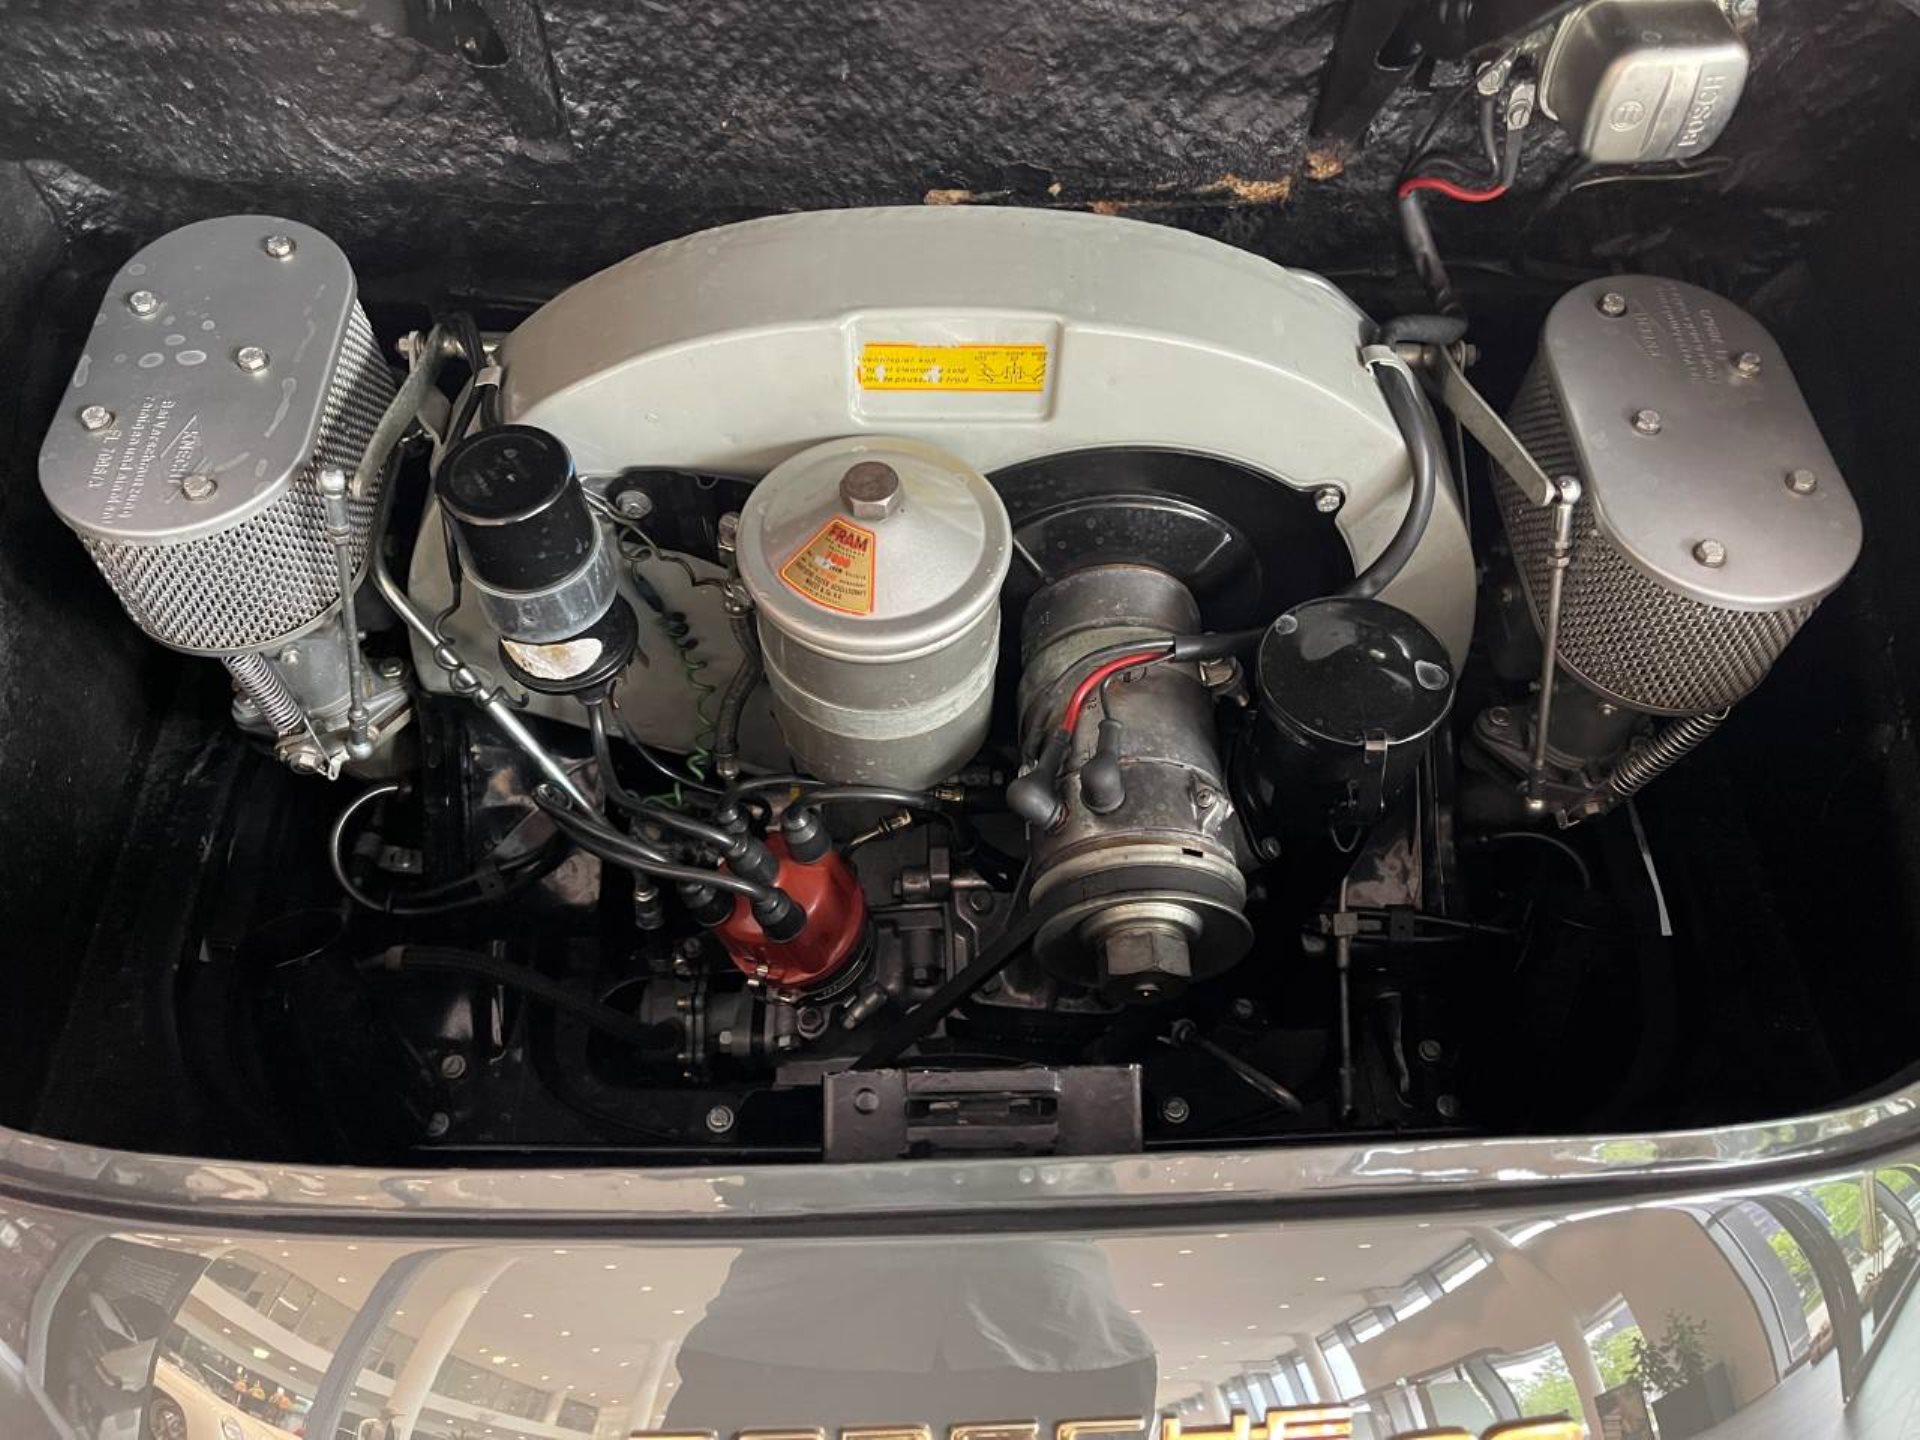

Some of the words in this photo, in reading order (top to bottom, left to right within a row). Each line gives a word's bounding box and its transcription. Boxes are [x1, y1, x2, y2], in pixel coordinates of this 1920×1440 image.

[1677, 75, 1726, 147] BOSCH
[167, 430, 199, 484] KNECHT
[828, 525, 867, 553] FRAM
